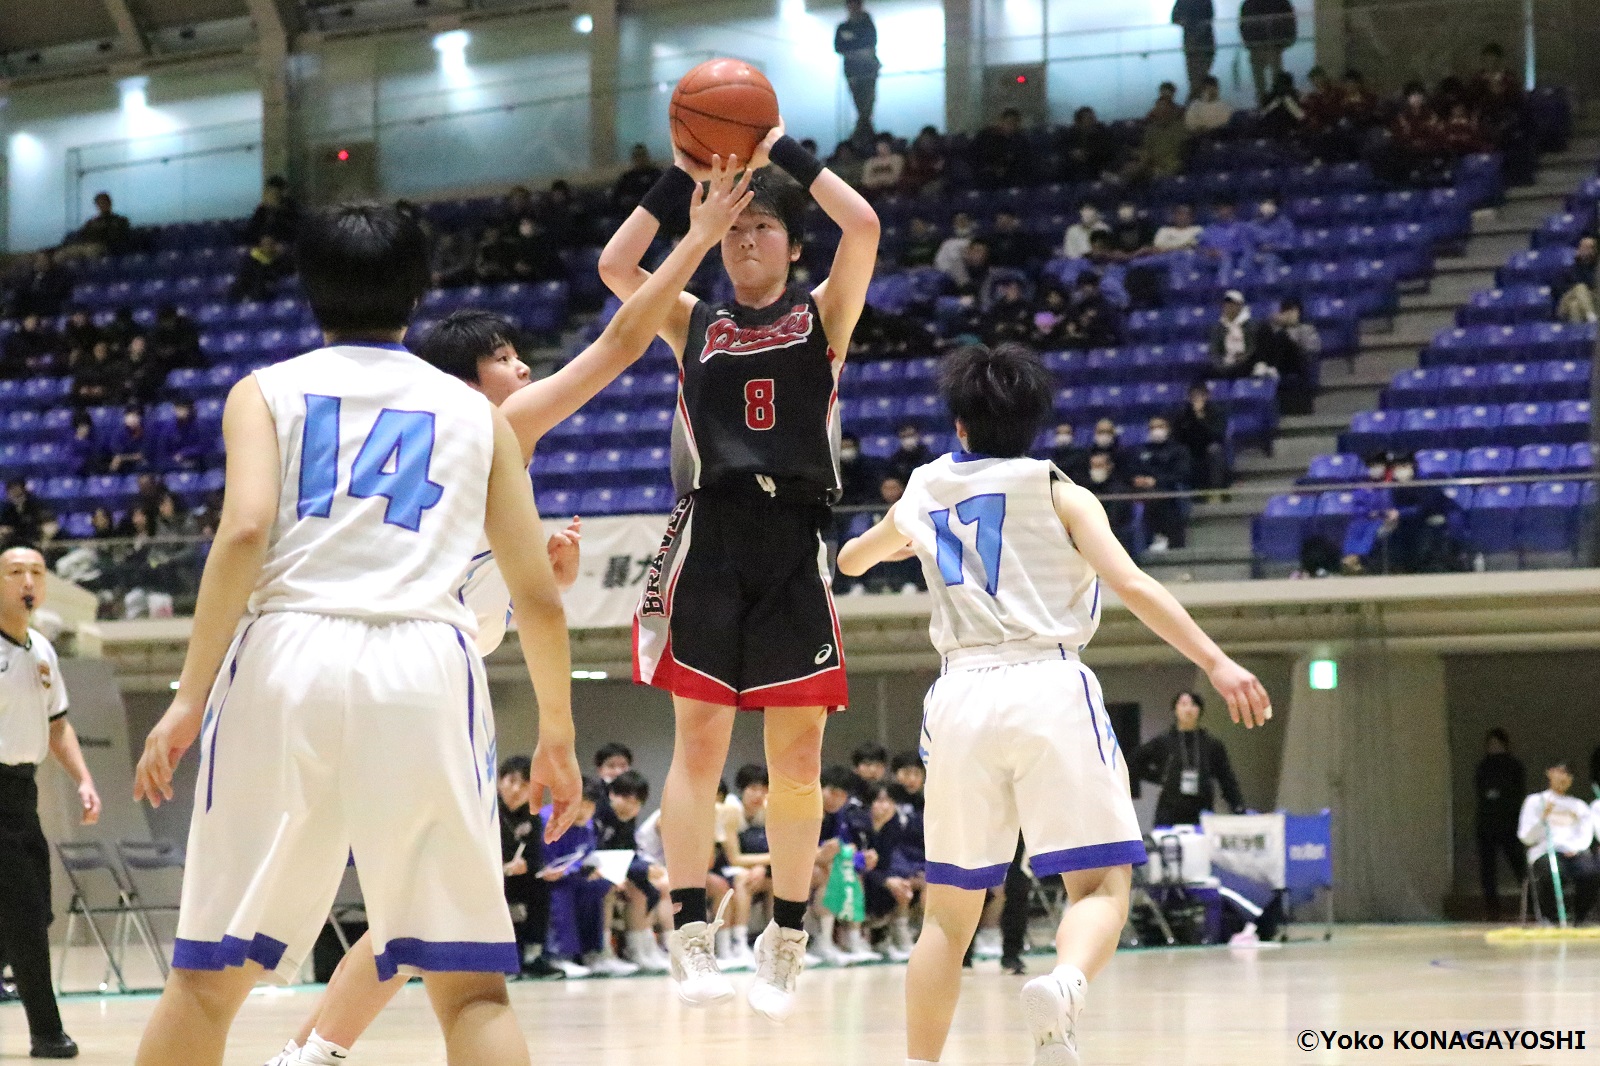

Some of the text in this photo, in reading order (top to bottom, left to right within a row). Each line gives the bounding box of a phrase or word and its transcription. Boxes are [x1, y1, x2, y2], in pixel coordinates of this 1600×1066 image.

[744, 378, 776, 431] 8
[296, 393, 445, 531] 14
[928, 492, 1006, 597] 17
